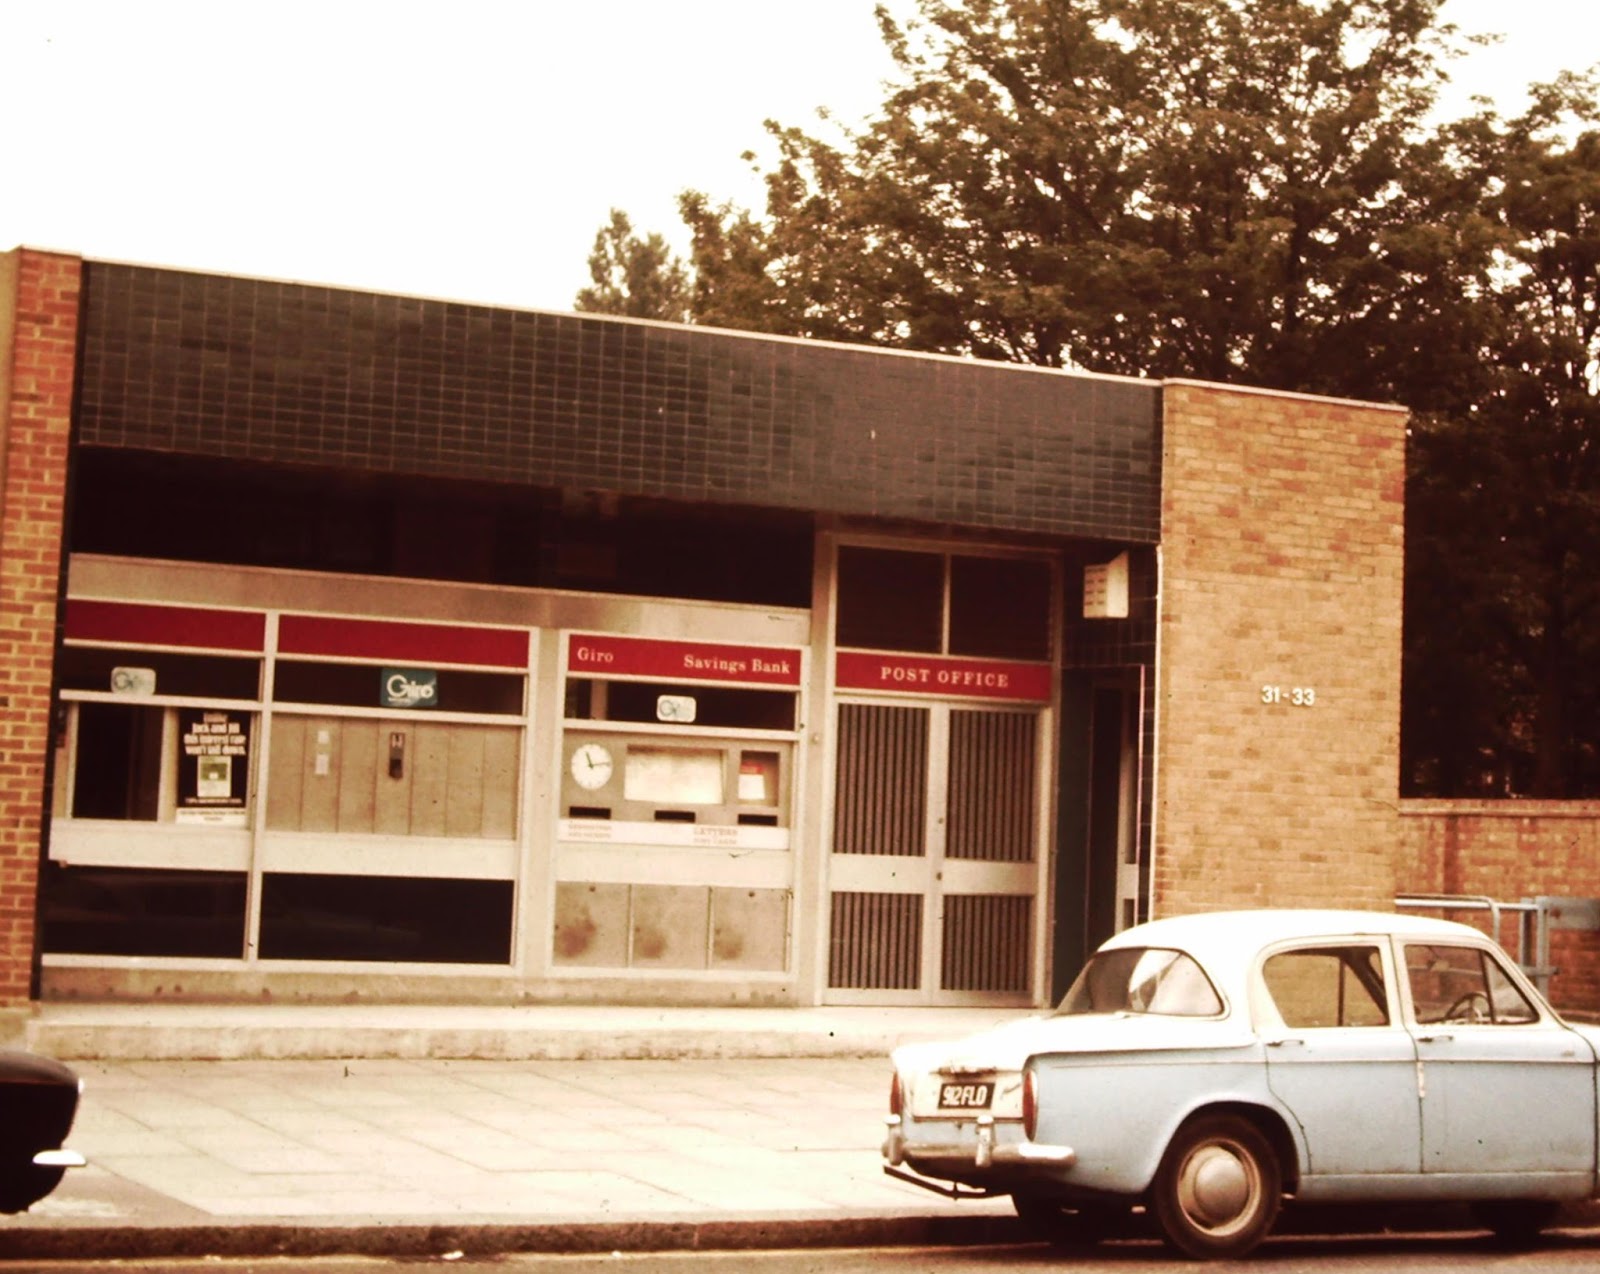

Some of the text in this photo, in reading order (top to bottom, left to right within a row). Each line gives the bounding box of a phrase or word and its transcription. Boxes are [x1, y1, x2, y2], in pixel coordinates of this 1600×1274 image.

[577, 647, 614, 663] Giro
[683, 654, 791, 674] Savings Bank
[386, 674, 435, 699] Giro
[880, 666, 1009, 688] POST OFFICE
